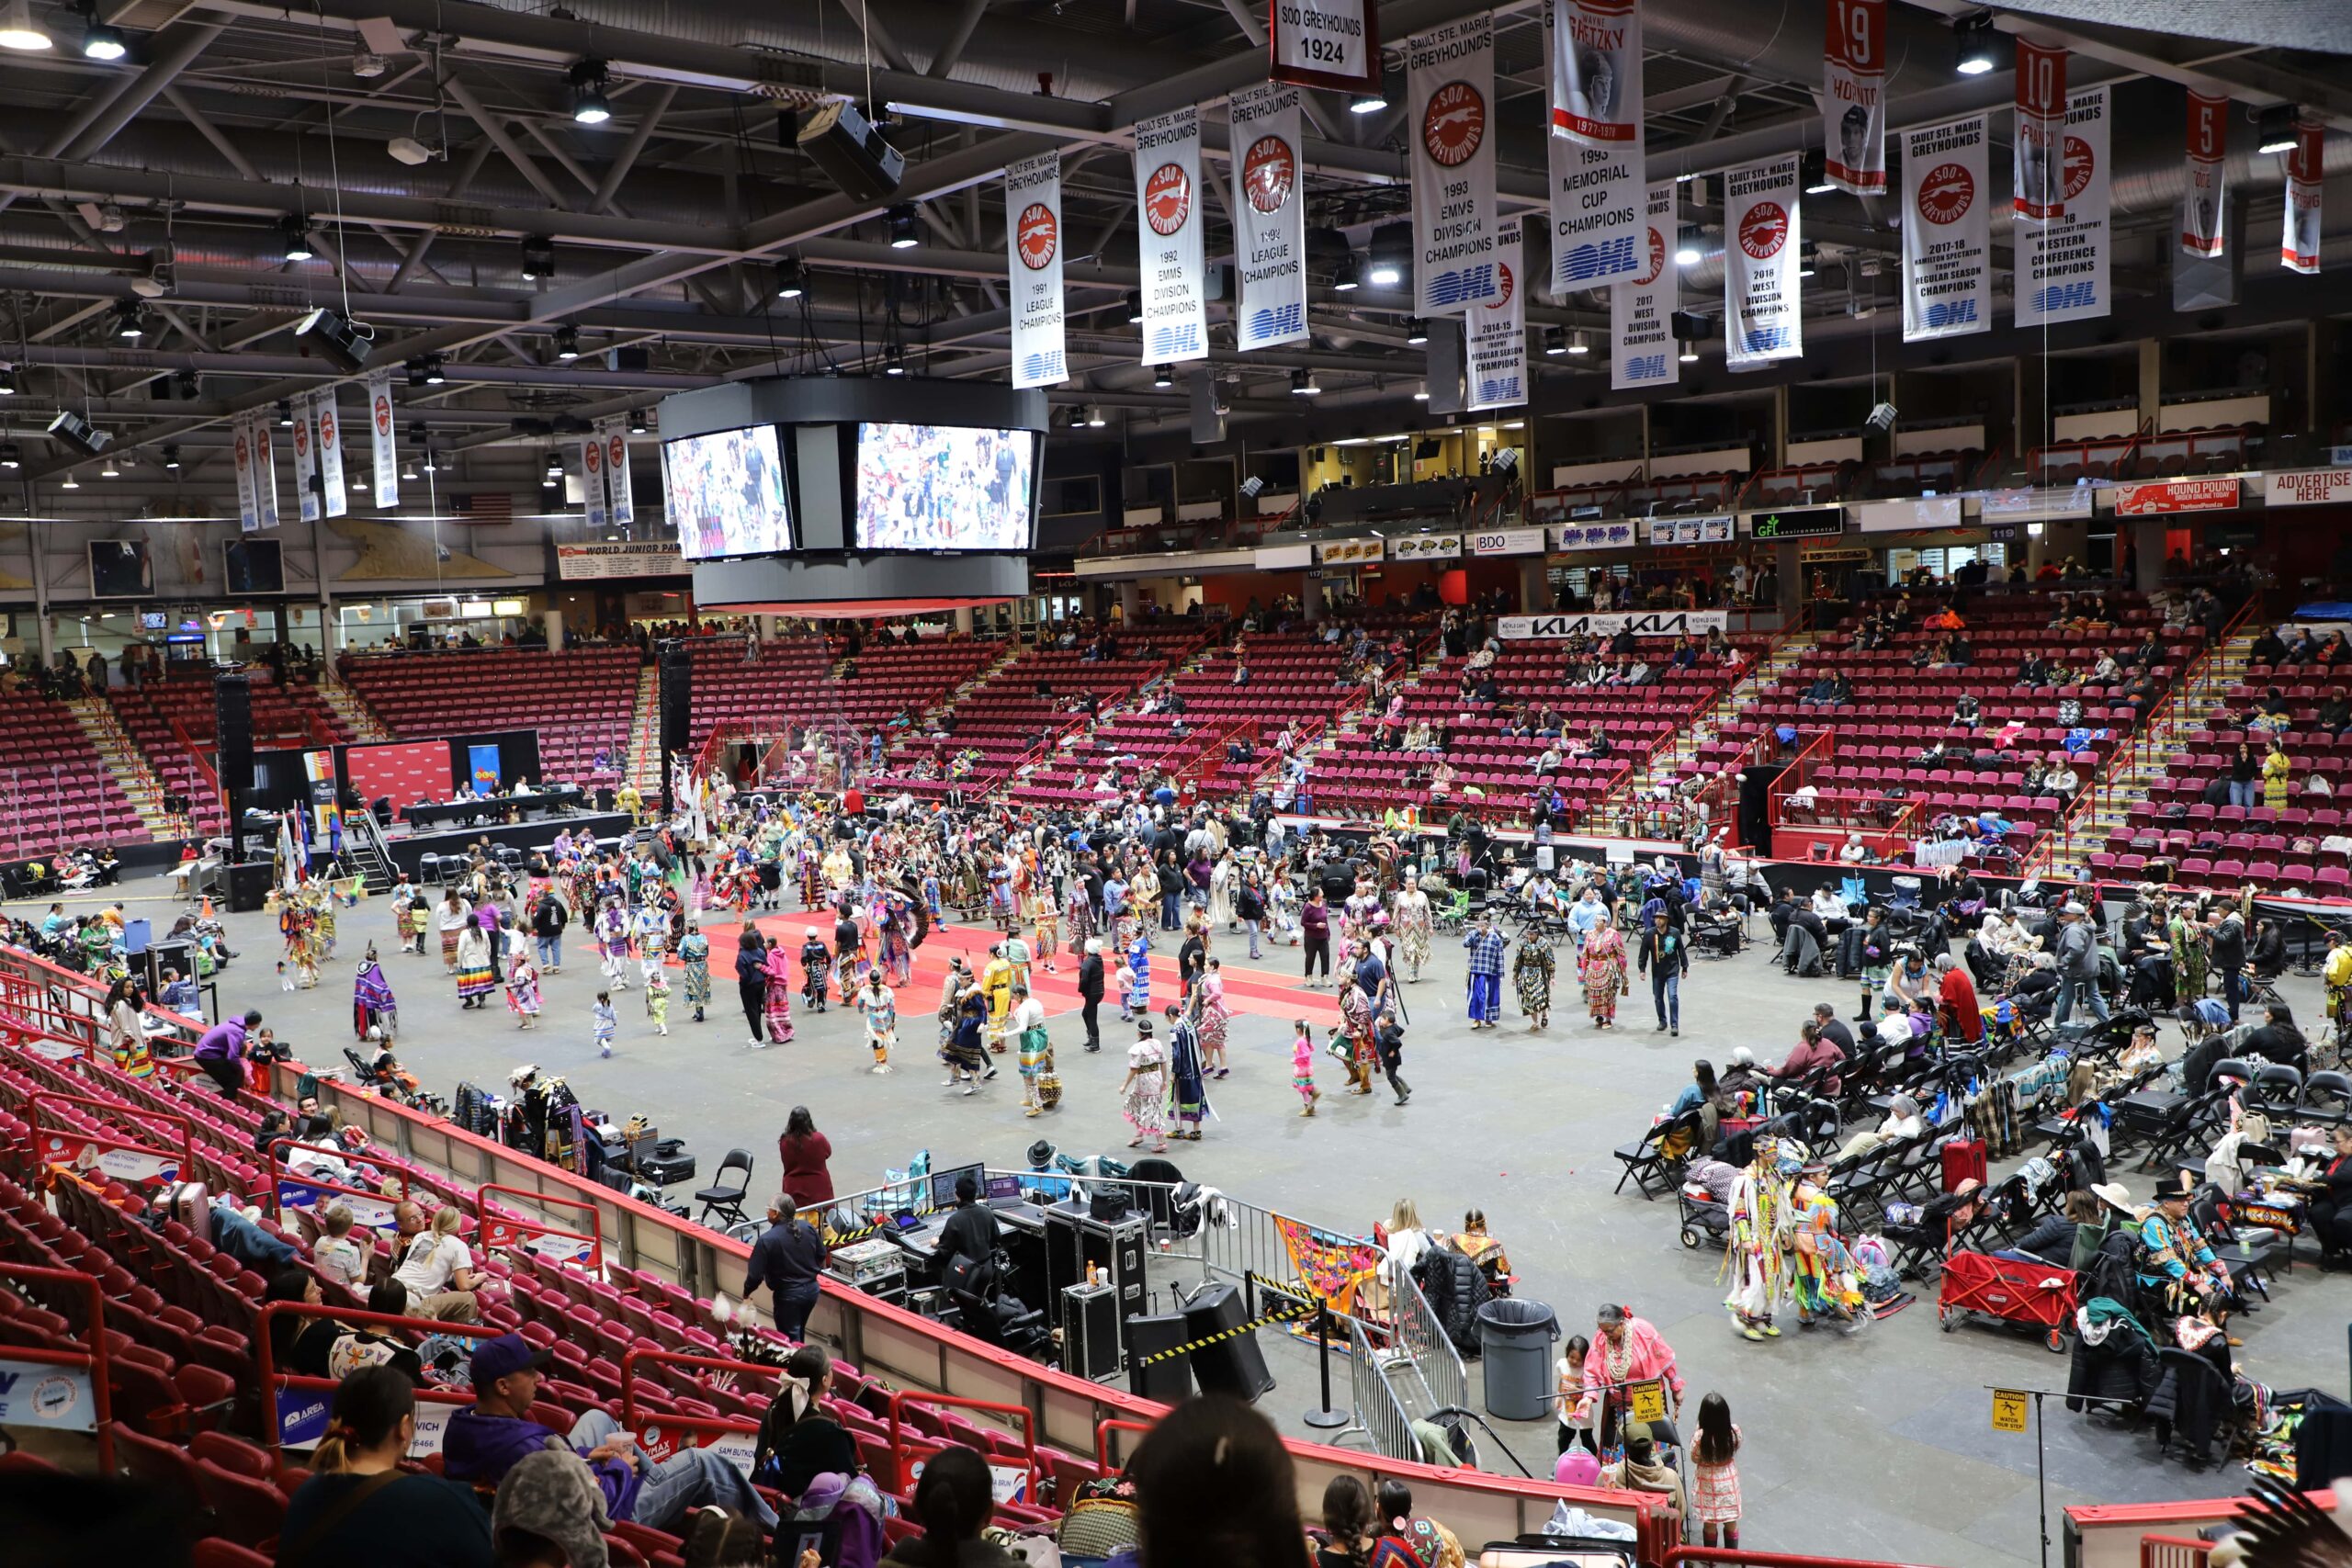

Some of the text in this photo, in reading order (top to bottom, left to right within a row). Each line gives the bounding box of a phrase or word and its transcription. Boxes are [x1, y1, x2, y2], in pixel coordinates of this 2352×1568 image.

[1283, 6, 1362, 37] SOO GREYHOUNDS
[1582, 14, 1605, 28] WAYNE
[1410, 16, 1490, 51] SAULT STE. MARIE
[1568, 15, 1624, 51] GRETZKY
[1838, 1, 1870, 64] 19
[1301, 37, 1344, 64] 1924
[1411, 31, 1491, 71] GREYHOUNDS
[2028, 53, 2053, 110] 10
[1231, 86, 1272, 107] SAULT STE.
[1440, 85, 1464, 107] SOO
[2074, 94, 2103, 109] MARIE
[1232, 91, 1299, 124] GREYHOUNDS
[1137, 109, 1196, 134] SAULT STE. MARIE
[2200, 107, 2212, 153] 5
[1137, 123, 1196, 150] GREYHOUNDS
[1911, 120, 1982, 145] SAULT STE. MARIE
[1256, 139, 1276, 158] SOO
[1429, 126, 1481, 164] GREYHOUNDS
[1912, 132, 1981, 158] GREYHOUNDS
[1037, 153, 1058, 166] MARIE
[2298, 134, 2308, 177] 4
[1008, 166, 1059, 191] GREYHOUNDS
[1159, 166, 1176, 184] SOO
[1564, 164, 1629, 192] MEMORIAL
[1728, 162, 1795, 184] SAULT STE. MARIE
[1935, 166, 1957, 182] SOO
[1444, 181, 1468, 198] 1993
[1730, 174, 1793, 197] GREYHOUNDS
[1582, 190, 1607, 209] CUP
[1649, 189, 1670, 201] MARIE
[1026, 206, 1042, 222] SOO
[1148, 202, 1187, 233] GREYHOUNDS
[1442, 199, 1474, 220] EMMS
[1754, 205, 1773, 219] SOO
[1922, 195, 1970, 222] GREYHOUNDS
[1434, 219, 1481, 242] DIVISION
[1559, 208, 1634, 236] CHAMPIONS
[2048, 226, 2075, 236] GRETZKY
[2076, 220, 2102, 231] TROPHY
[1261, 229, 1281, 243] 1992
[1742, 231, 1785, 257] GREYHOUNDS
[2038, 233, 2086, 251] WESTERN
[1021, 239, 1055, 268] GREYHOUNDS
[1252, 244, 1288, 264] LEAGUE
[1426, 237, 1492, 264] CHAMPIONS
[1929, 239, 1965, 254] 2017-18
[1160, 250, 1178, 264] 1992
[1558, 236, 1638, 283] OHL
[1915, 248, 1982, 265] HAMILTON SPECTATOR
[2031, 246, 2096, 266] CONFERENCE
[1159, 267, 1182, 281] EMMS
[1244, 260, 1298, 284] CHAMPIONS
[1754, 268, 1774, 279] 2018
[1935, 261, 1960, 271] TROPHY
[2033, 261, 2094, 280] CHAMPIONS
[1916, 266, 1982, 285] REGULAR SEASON
[1032, 284, 1047, 295] 1991
[1154, 284, 1189, 300] DIVISION
[1425, 264, 1495, 308] OHL
[1752, 281, 1775, 292] WEST
[1920, 279, 1976, 297] CHAMPIONS
[1026, 298, 1053, 312] LEAGUE
[1636, 296, 1653, 306] 2017
[1747, 292, 1781, 306] DIVISION
[2030, 281, 2097, 312] OHL
[1147, 300, 1196, 319] CHAMPIONS
[1634, 308, 1654, 319] WEST
[1741, 303, 1789, 319] CHAMPIONS
[1920, 299, 1978, 327] OHL
[1020, 312, 1061, 331] CHAMPIONS
[1246, 303, 1303, 340] OHL
[1482, 321, 1511, 333] 2014-15
[1628, 320, 1660, 333] DIVISION
[1150, 323, 1200, 355] OHL
[1471, 334, 1495, 343] HAMILTON
[1487, 341, 1507, 349] TROPHY
[1623, 332, 1666, 346] CHAMPIONS
[1740, 327, 1792, 353] OHL
[1472, 346, 1523, 360] REGULAR SEASON
[1020, 350, 1064, 380] OHL
[1476, 358, 1519, 372] CHAMPIONS
[1623, 355, 1667, 380] OHL
[1476, 378, 1521, 401] OHL
[2167, 480, 2236, 496] HOUND POUND
[2277, 472, 2351, 490] ADVERTISE
[2297, 487, 2330, 502] HERE
[1656, 532, 1668, 540] 105
[1681, 530, 1695, 538] 105
[1708, 528, 1723, 536] 105
[1758, 518, 1779, 536] GFL
[1781, 525, 1837, 536] environmental
[1992, 529, 2014, 537] 119
[586, 545, 659, 555] WORLD JUNIOR
[1479, 536, 1505, 548] BDO
[1634, 1383, 1659, 1393] CAUTION
[1996, 1392, 2025, 1401] CAUTION
[301, 1402, 325, 1419] AREA
